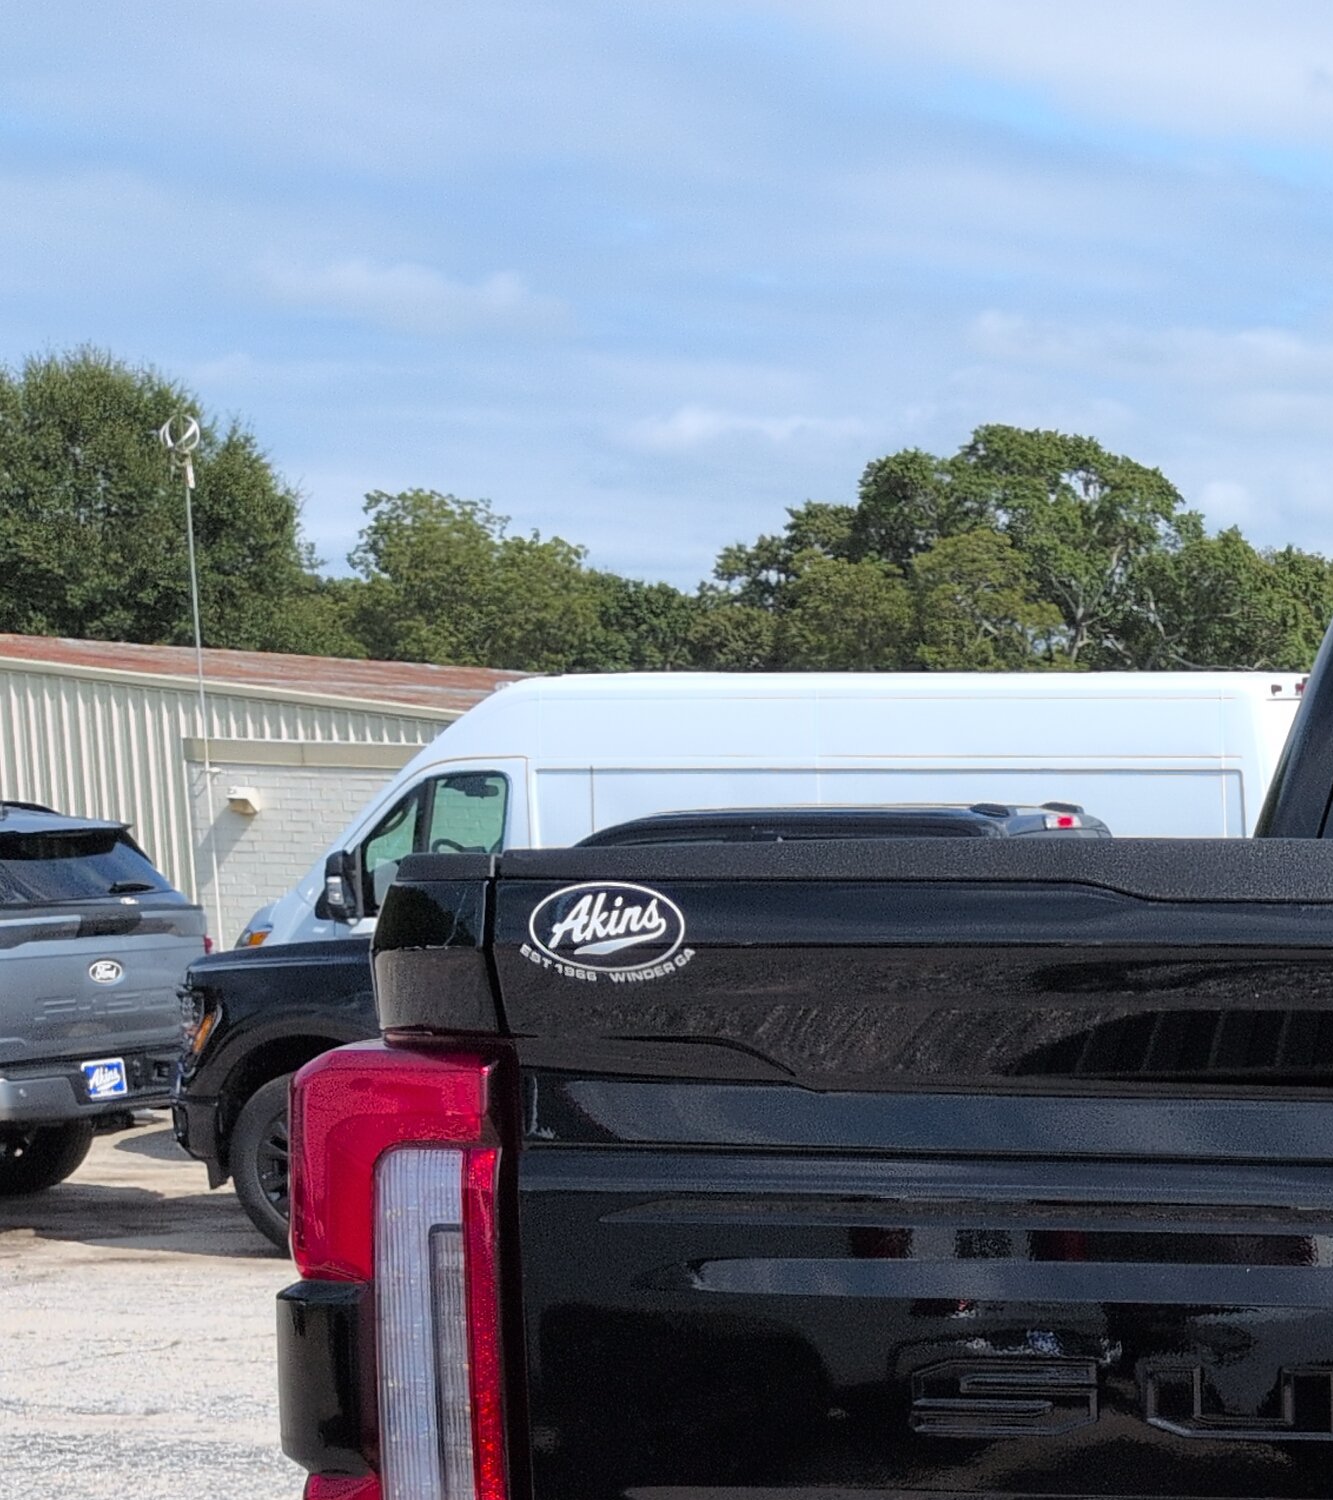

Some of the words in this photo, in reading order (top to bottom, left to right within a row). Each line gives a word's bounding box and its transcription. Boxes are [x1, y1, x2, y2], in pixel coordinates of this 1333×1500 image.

[548, 893, 666, 950] Akins
[519, 943, 552, 969] EST
[554, 964, 597, 982] 1966
[609, 961, 676, 983] WINDER
[674, 948, 696, 967] GA
